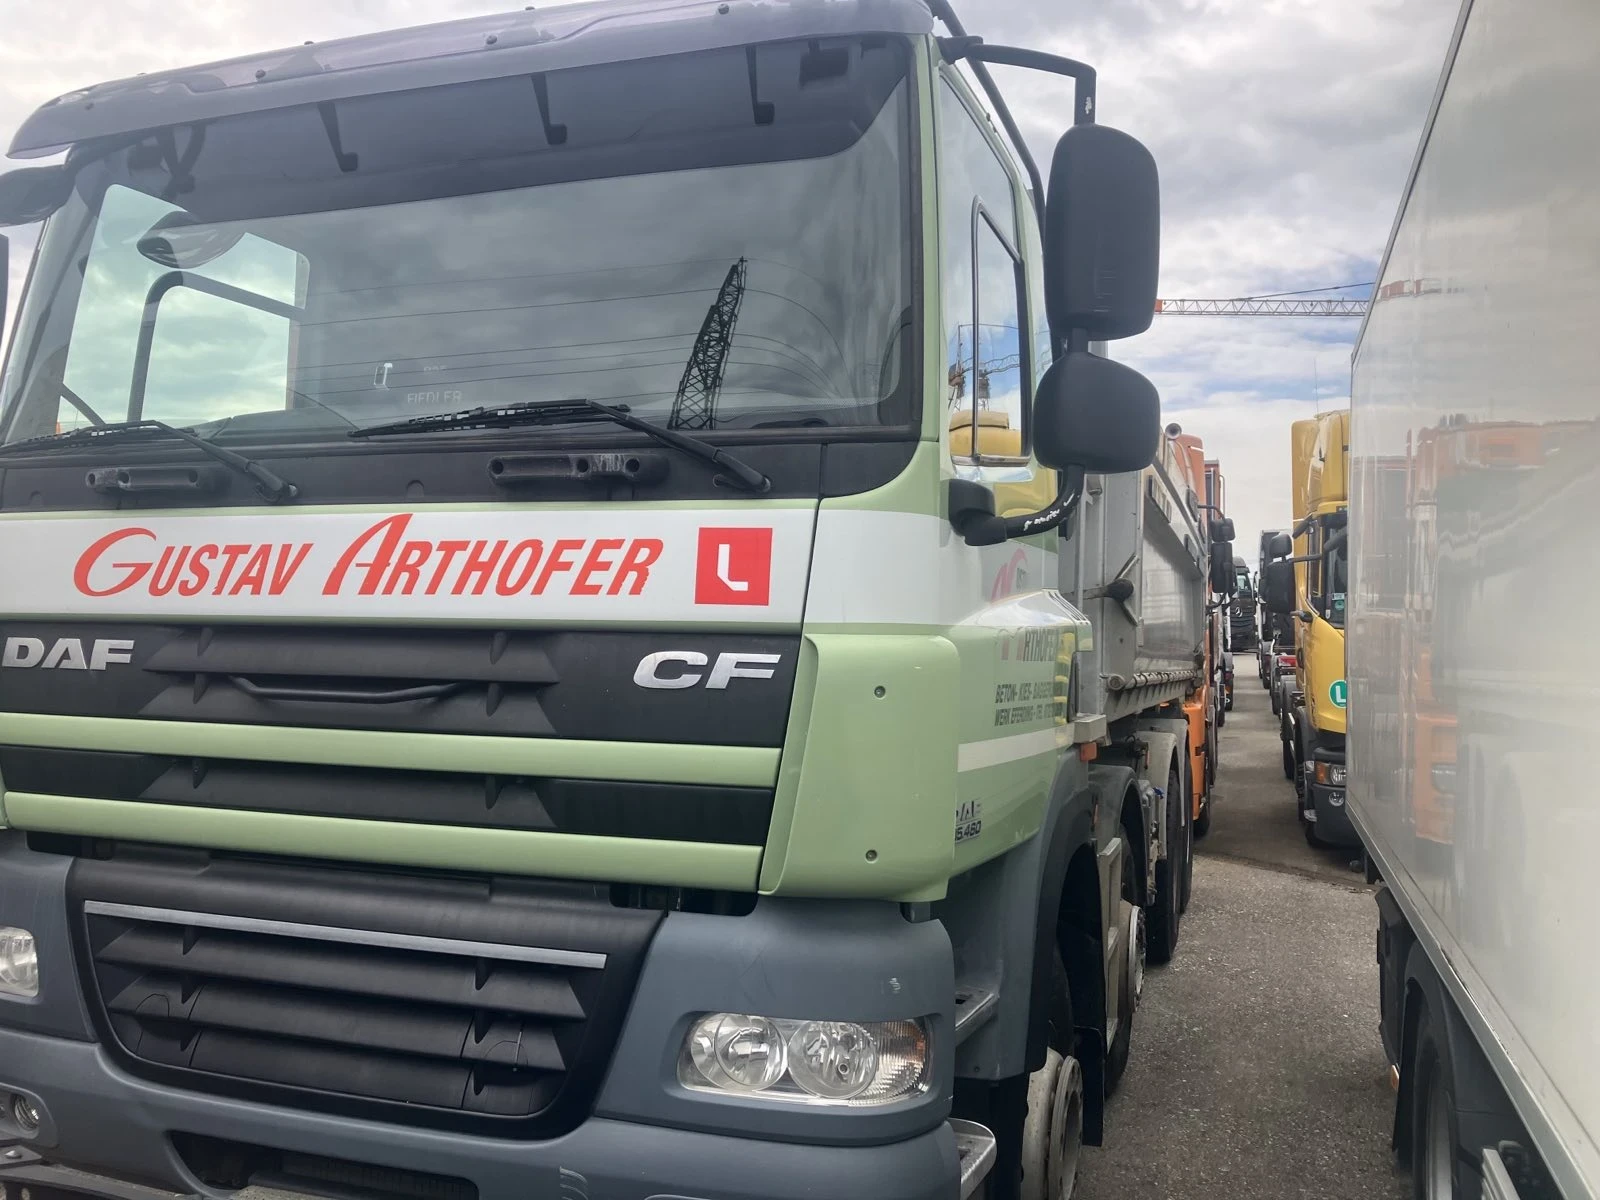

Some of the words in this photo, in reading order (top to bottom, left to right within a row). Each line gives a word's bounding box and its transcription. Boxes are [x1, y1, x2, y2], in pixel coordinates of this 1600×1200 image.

[73, 527, 314, 597] GUSTAV
[321, 513, 664, 596] ARTHOFER
[2, 637, 135, 670] DAF
[633, 651, 782, 689] CF
